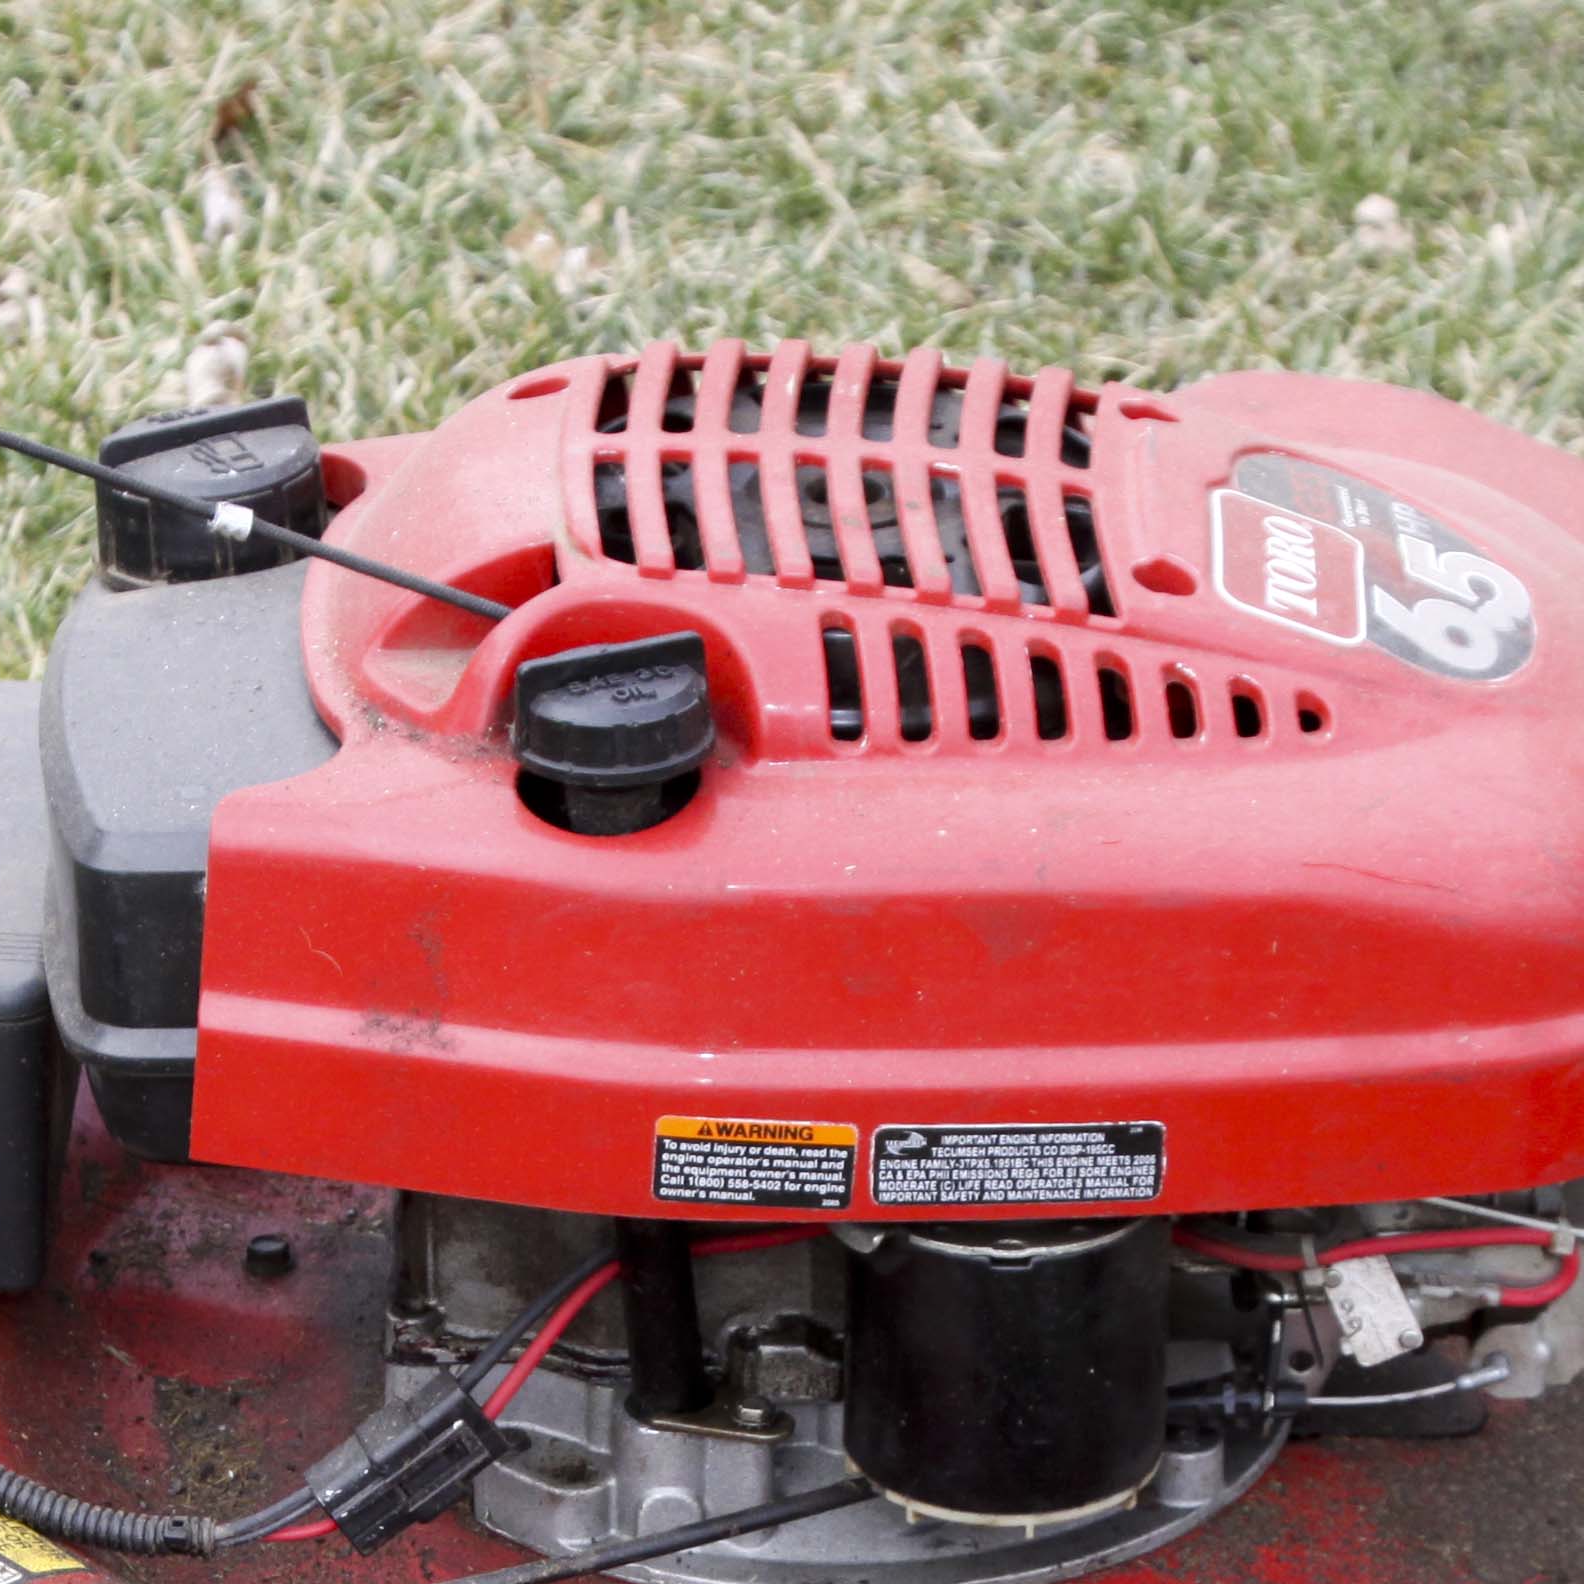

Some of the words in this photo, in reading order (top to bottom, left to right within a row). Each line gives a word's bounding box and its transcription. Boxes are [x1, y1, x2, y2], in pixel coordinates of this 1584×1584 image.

[1262, 514, 1318, 617] TORO
[612, 685, 657, 703] OIL
[716, 1122, 814, 1141] WARNING
[941, 1135, 997, 1146] IMPORTANT
[999, 1134, 1036, 1145] ENGINE
[1038, 1133, 1105, 1144] INFORMATION
[663, 1139, 677, 1150] To
[680, 1142, 711, 1153] avoid
[714, 1143, 747, 1156] injury
[748, 1146, 762, 1155] or
[801, 1148, 827, 1158] read
[829, 1149, 849, 1159] the
[932, 1147, 986, 1157] TECUMSEH
[987, 1146, 1041, 1156] PRODUCTS
[1043, 1145, 1058, 1156] CO
[662, 1152, 704, 1165] engine
[707, 1156, 770, 1167] operator's
[773, 1158, 818, 1169] manual
[821, 1160, 845, 1170] and
[880, 1159, 918, 1170] ENGINE
[1031, 1157, 1054, 1167] THIS
[1056, 1156, 1095, 1167] ENGINE
[1097, 1155, 1131, 1166] MEETS
[662, 1163, 681, 1173] the
[683, 1165, 747, 1178] equipment
[750, 1169, 796, 1180] owner's
[799, 1171, 846, 1182] manual.
[879, 1170, 894, 1180] CA
[906, 1169, 927, 1180] EPA
[952, 1168, 1008, 1179] EMISSIONS
[1010, 1168, 1040, 1178] REGS
[1042, 1167, 1064, 1178] FOR
[1079, 1166, 1107, 1177] SORE
[1109, 1165, 1156, 1176] ENGINES
[660, 1174, 685, 1185] Call
[727, 1178, 782, 1190] 558-5402
[784, 1181, 802, 1191] for
[804, 1183, 846, 1195] engine
[879, 1180, 937, 1191] MODERATE
[940, 1180, 956, 1192] (C)
[958, 1180, 981, 1190] LIFE
[984, 1179, 1013, 1190] READ
[1085, 1177, 1129, 1188] MANUAL
[1132, 1176, 1154, 1186] FOR
[659, 1187, 706, 1199] owner's
[709, 1190, 756, 1201] manual.
[879, 1191, 938, 1202] IMPORTANT
[940, 1191, 980, 1201] SAFETY
[982, 1190, 1005, 1201] AND
[1007, 1188, 1080, 1200] MAINTENANCE
[1083, 1187, 1154, 1198] INFORMATION
[4, 1533, 33, 1549] OR
